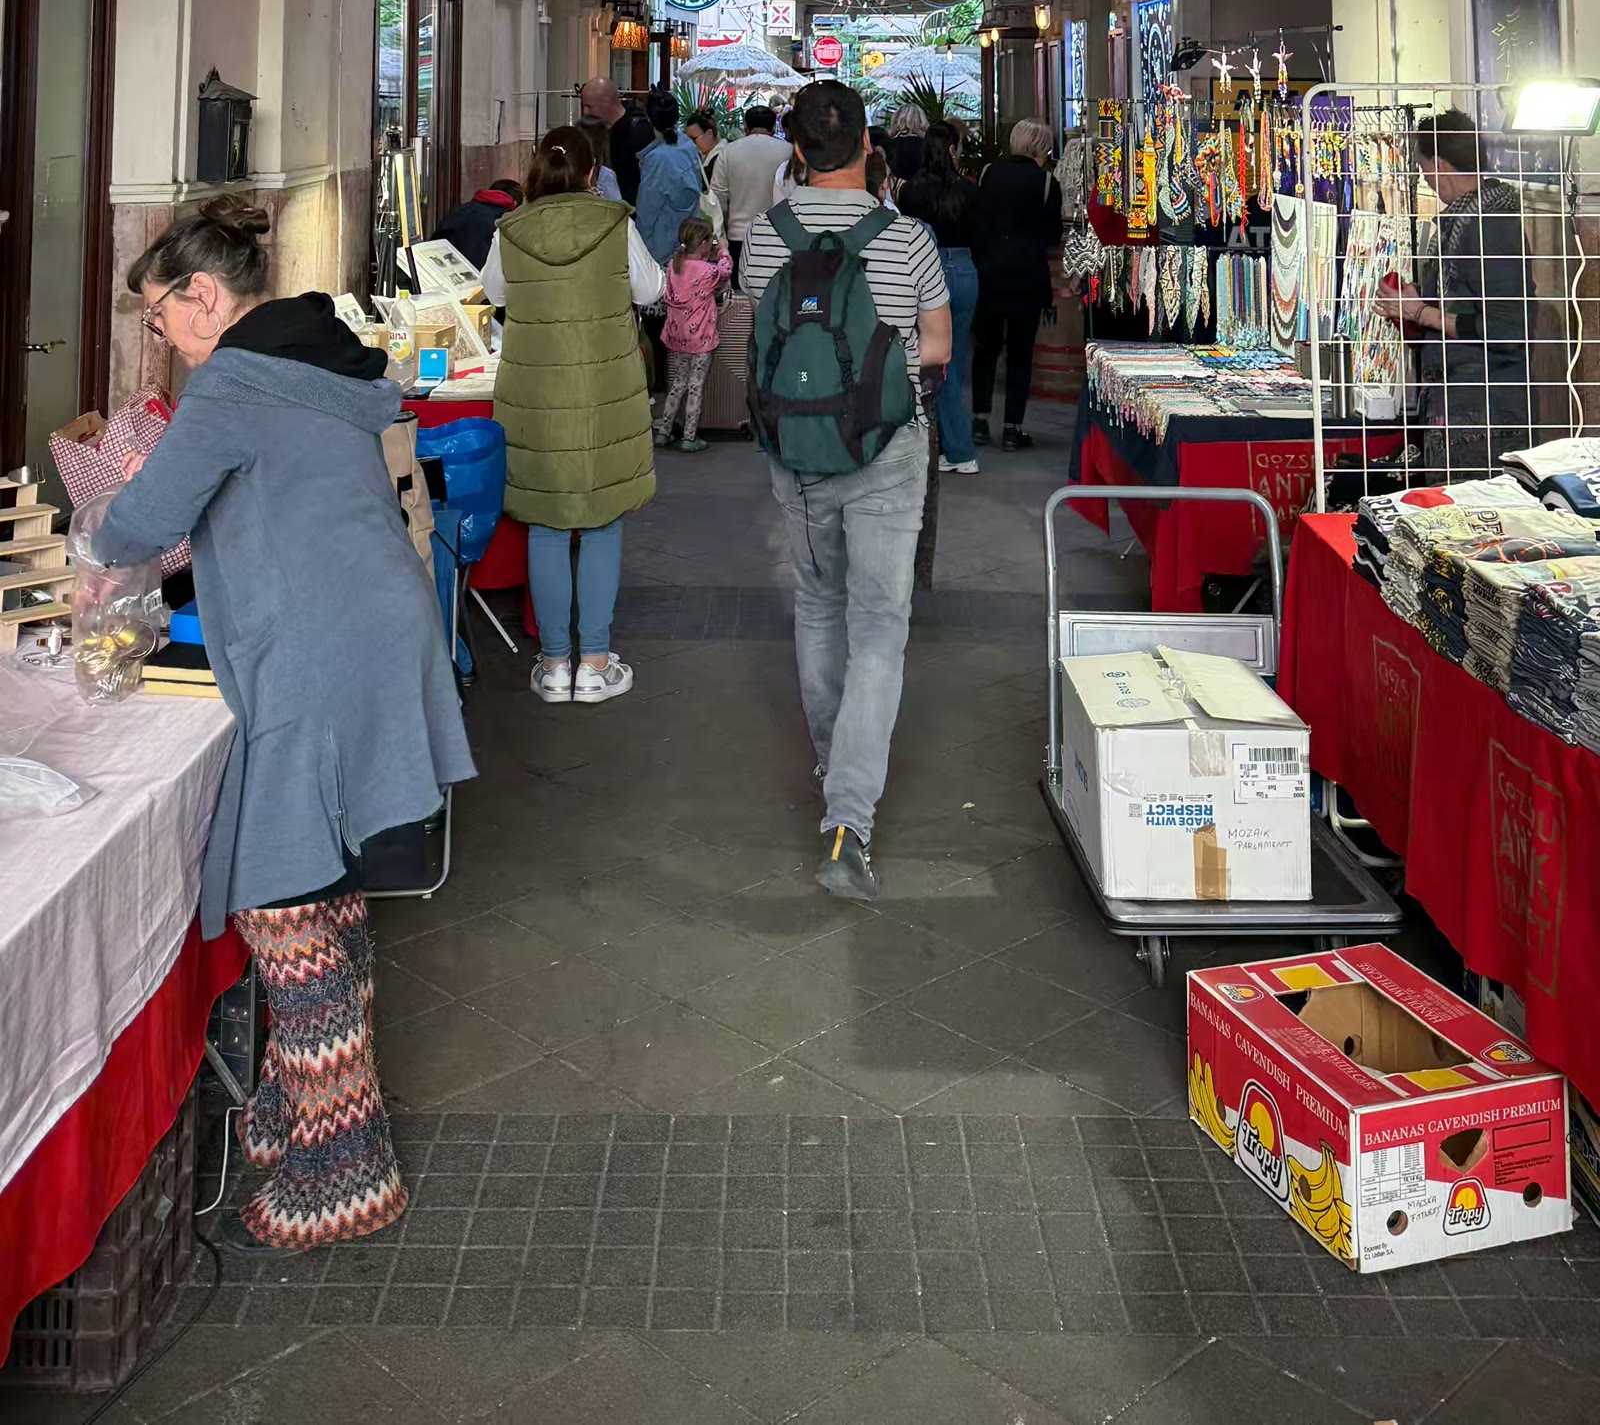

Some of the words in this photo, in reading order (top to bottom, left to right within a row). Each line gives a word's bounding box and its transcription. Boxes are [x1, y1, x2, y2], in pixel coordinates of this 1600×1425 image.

[1227, 225, 1272, 253] AT
[390, 332, 407, 340] ana
[1146, 804, 1214, 816] RESPECT
[1146, 816, 1177, 826] WITH
[1178, 816, 1214, 826] MADE
[1190, 991, 1231, 1039] BANANAS
[1234, 1032, 1291, 1092] CAVENDISH
[1295, 1083, 1348, 1140] PREMIUM
[1364, 1123, 1425, 1146] BANANAS
[1427, 1109, 1500, 1134] CAVENDISH
[1502, 1097, 1561, 1120] PREMIUM
[1242, 1115, 1283, 1187] Tropy
[1448, 1203, 1485, 1225] Tropy
